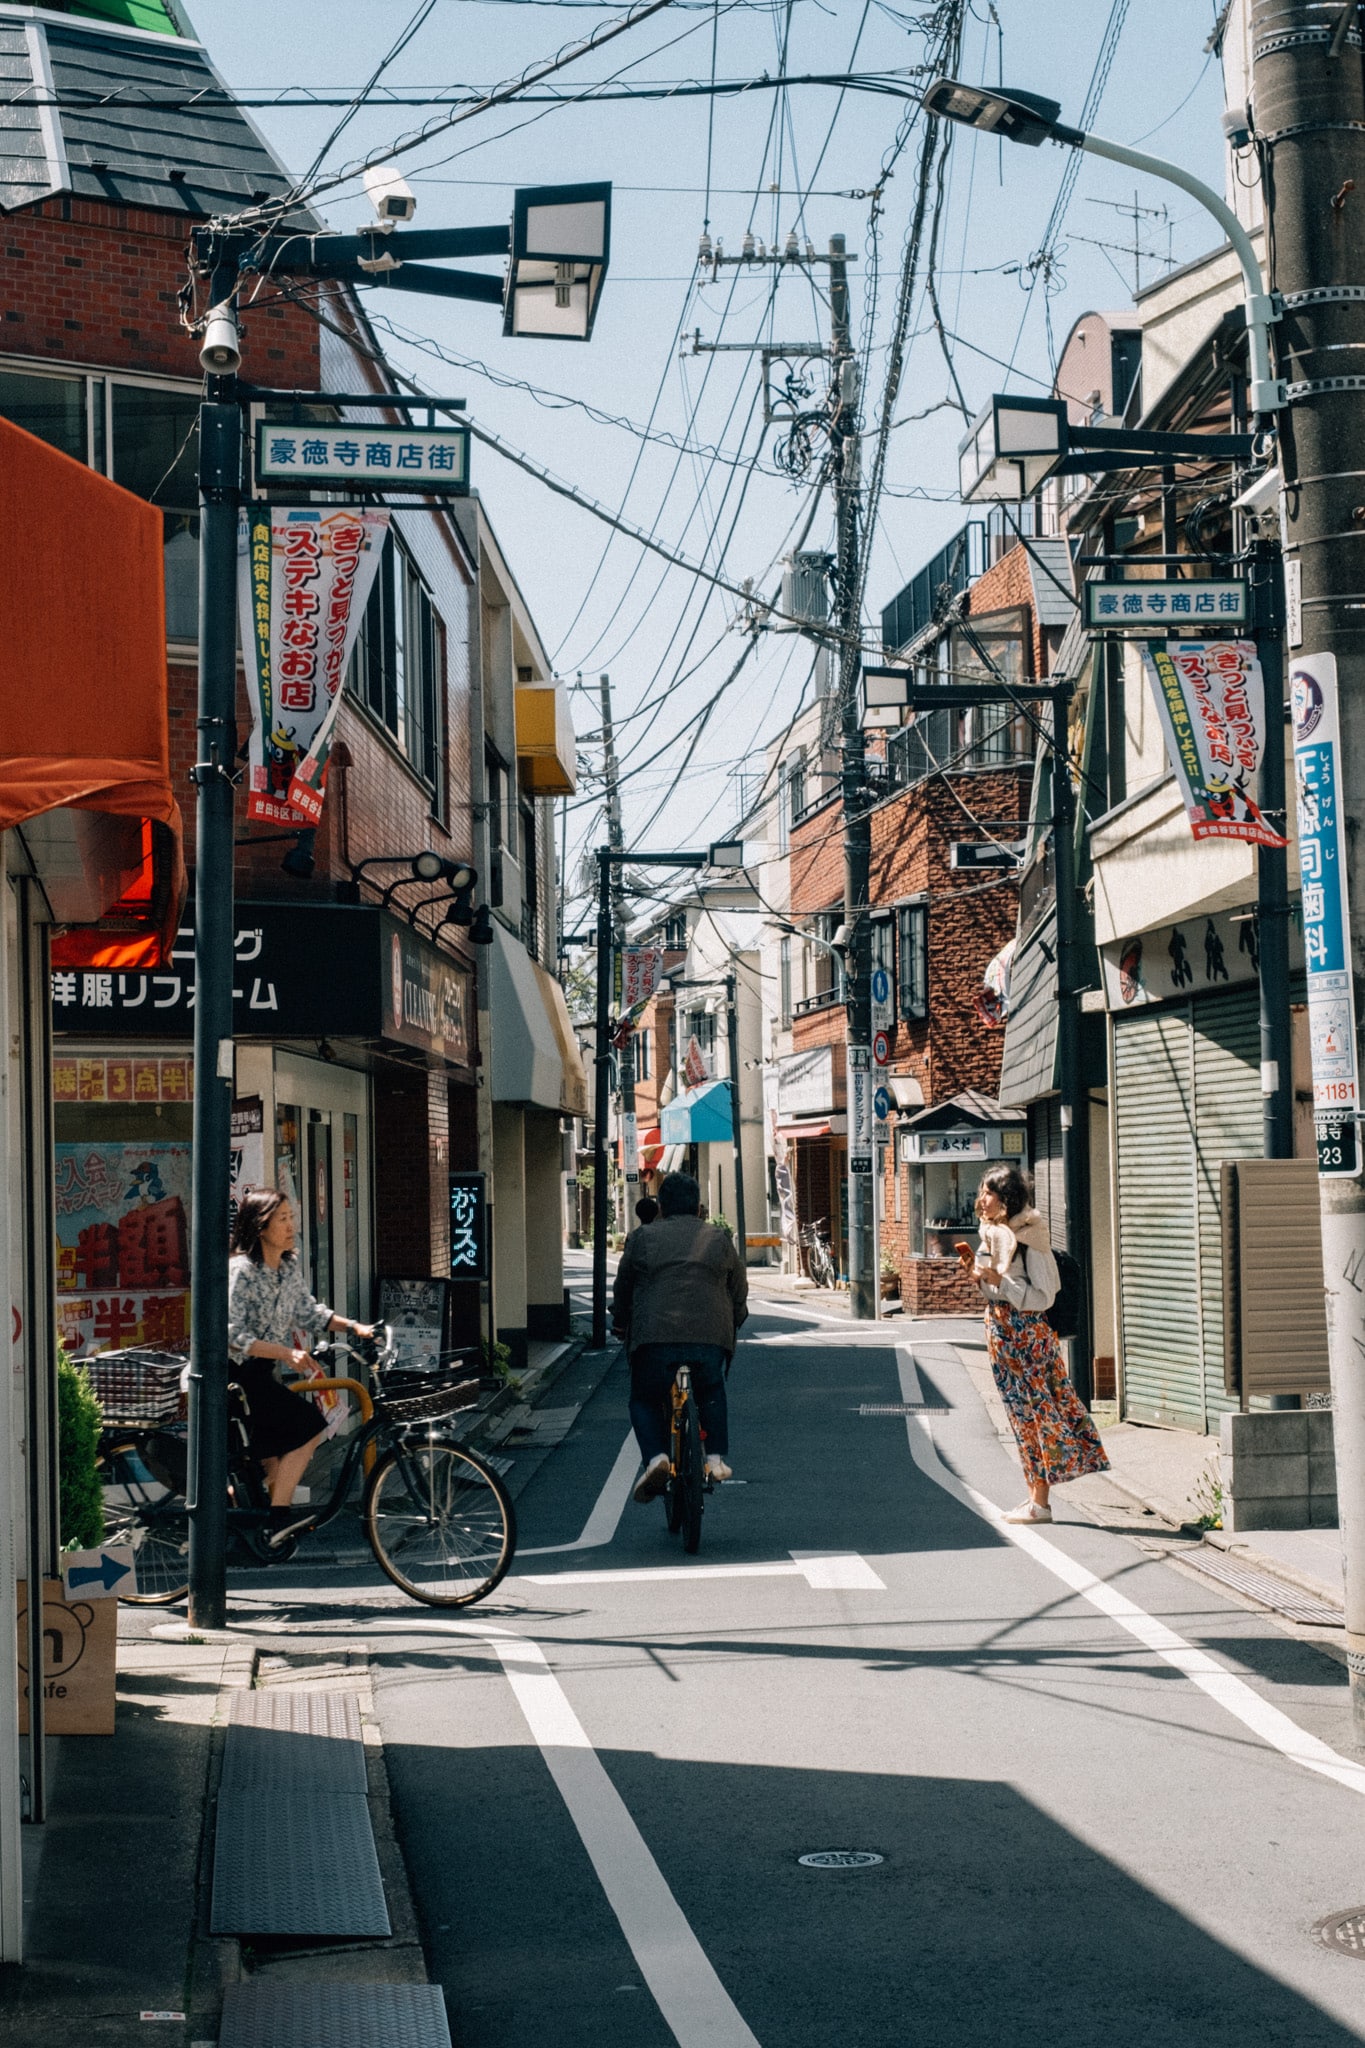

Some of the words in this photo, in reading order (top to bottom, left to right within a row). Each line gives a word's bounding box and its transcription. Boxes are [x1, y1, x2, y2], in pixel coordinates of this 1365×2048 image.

[270, 438, 455, 471] 豪徳寺商店街
[280, 527, 318, 708] ステキなお店
[326, 525, 364, 694] きっと見つかる
[1097, 592, 1240, 615] 豪徳寺商店街
[1320, 751, 1331, 785] しょう
[1322, 796, 1334, 828] げん
[1325, 848, 1335, 861] じ
[171, 928, 263, 961] ニグ
[24, 1682, 67, 1698] cfe
